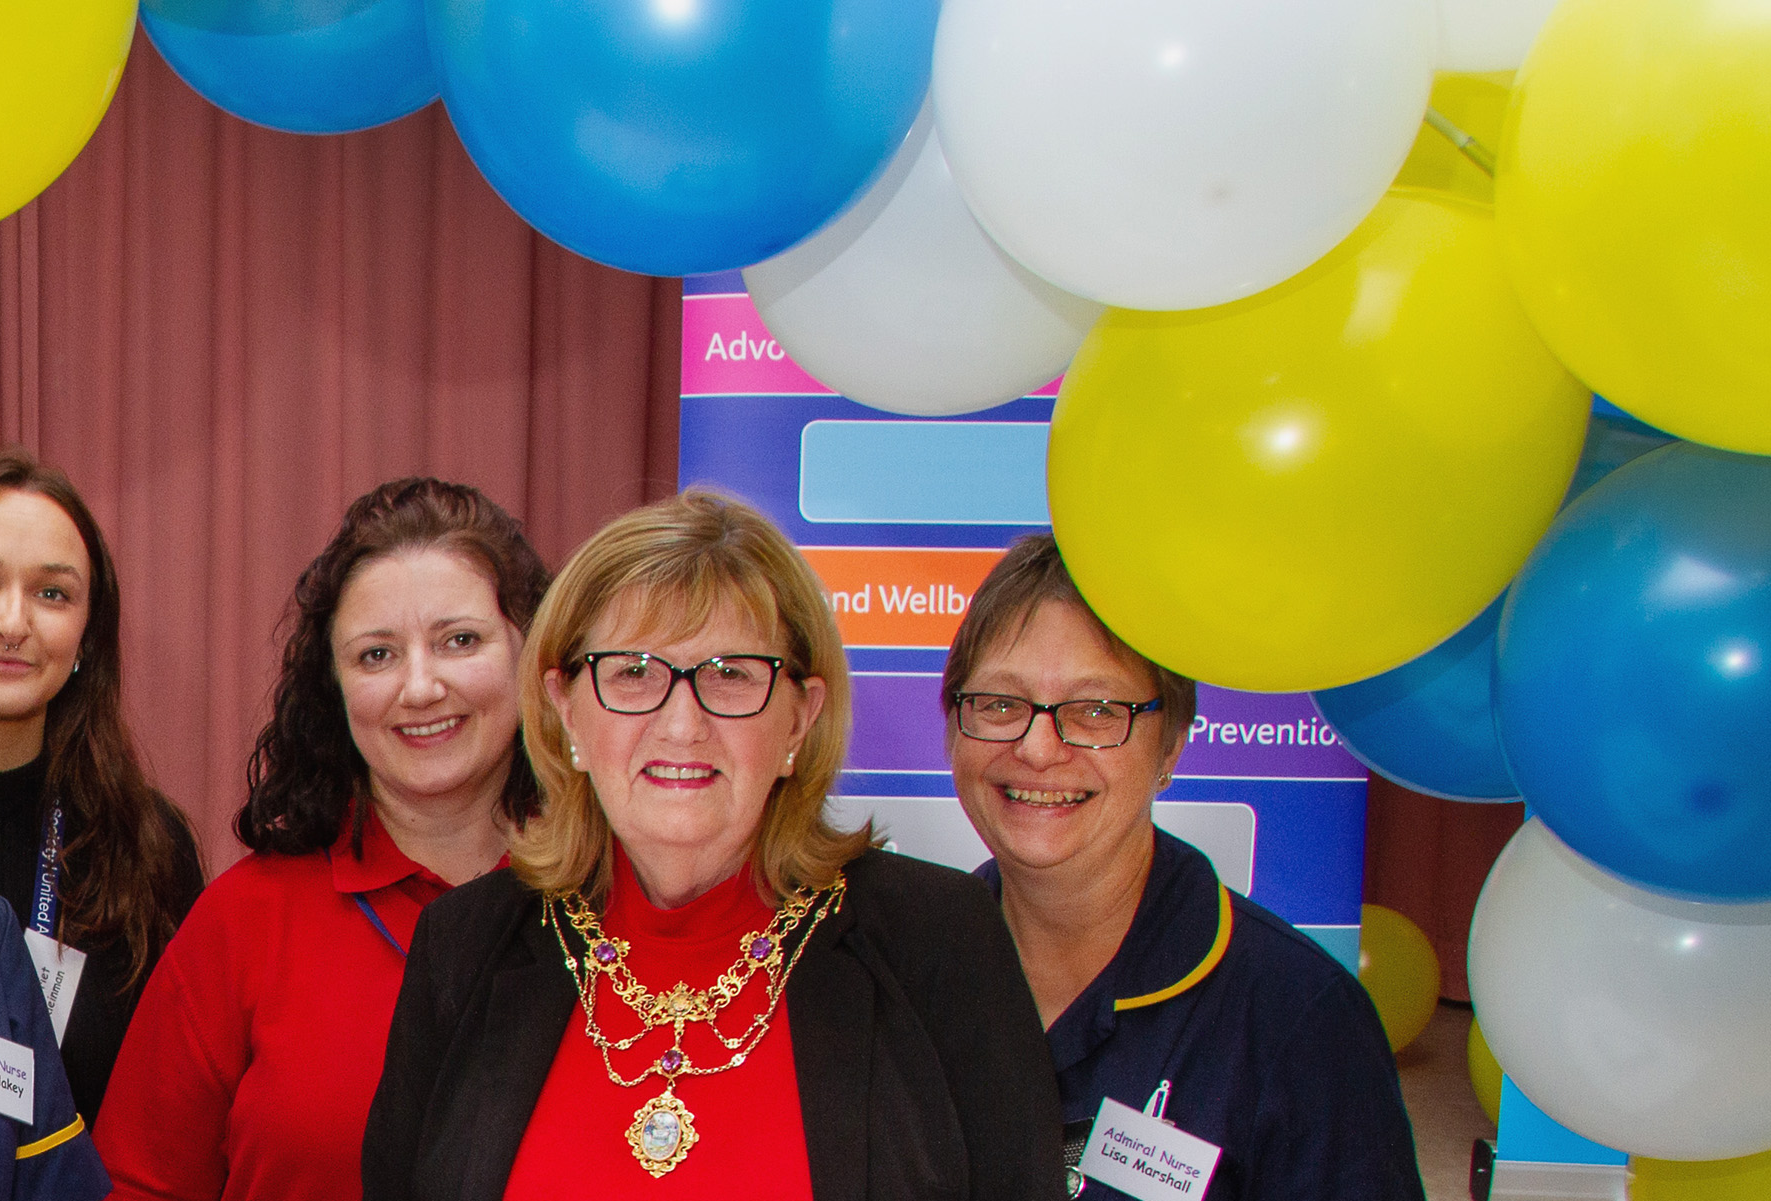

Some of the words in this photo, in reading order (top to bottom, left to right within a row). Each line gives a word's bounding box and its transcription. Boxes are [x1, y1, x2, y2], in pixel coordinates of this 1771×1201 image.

[822, 584, 871, 613] nd
[878, 584, 973, 615] Wellb
[1188, 715, 1343, 746] Preventio
[1101, 1143, 1128, 1165] Lisa
[1132, 1158, 1192, 1194] Marshall
[1104, 1127, 1156, 1158] Admiral
[1159, 1150, 1200, 1179] Nurse
